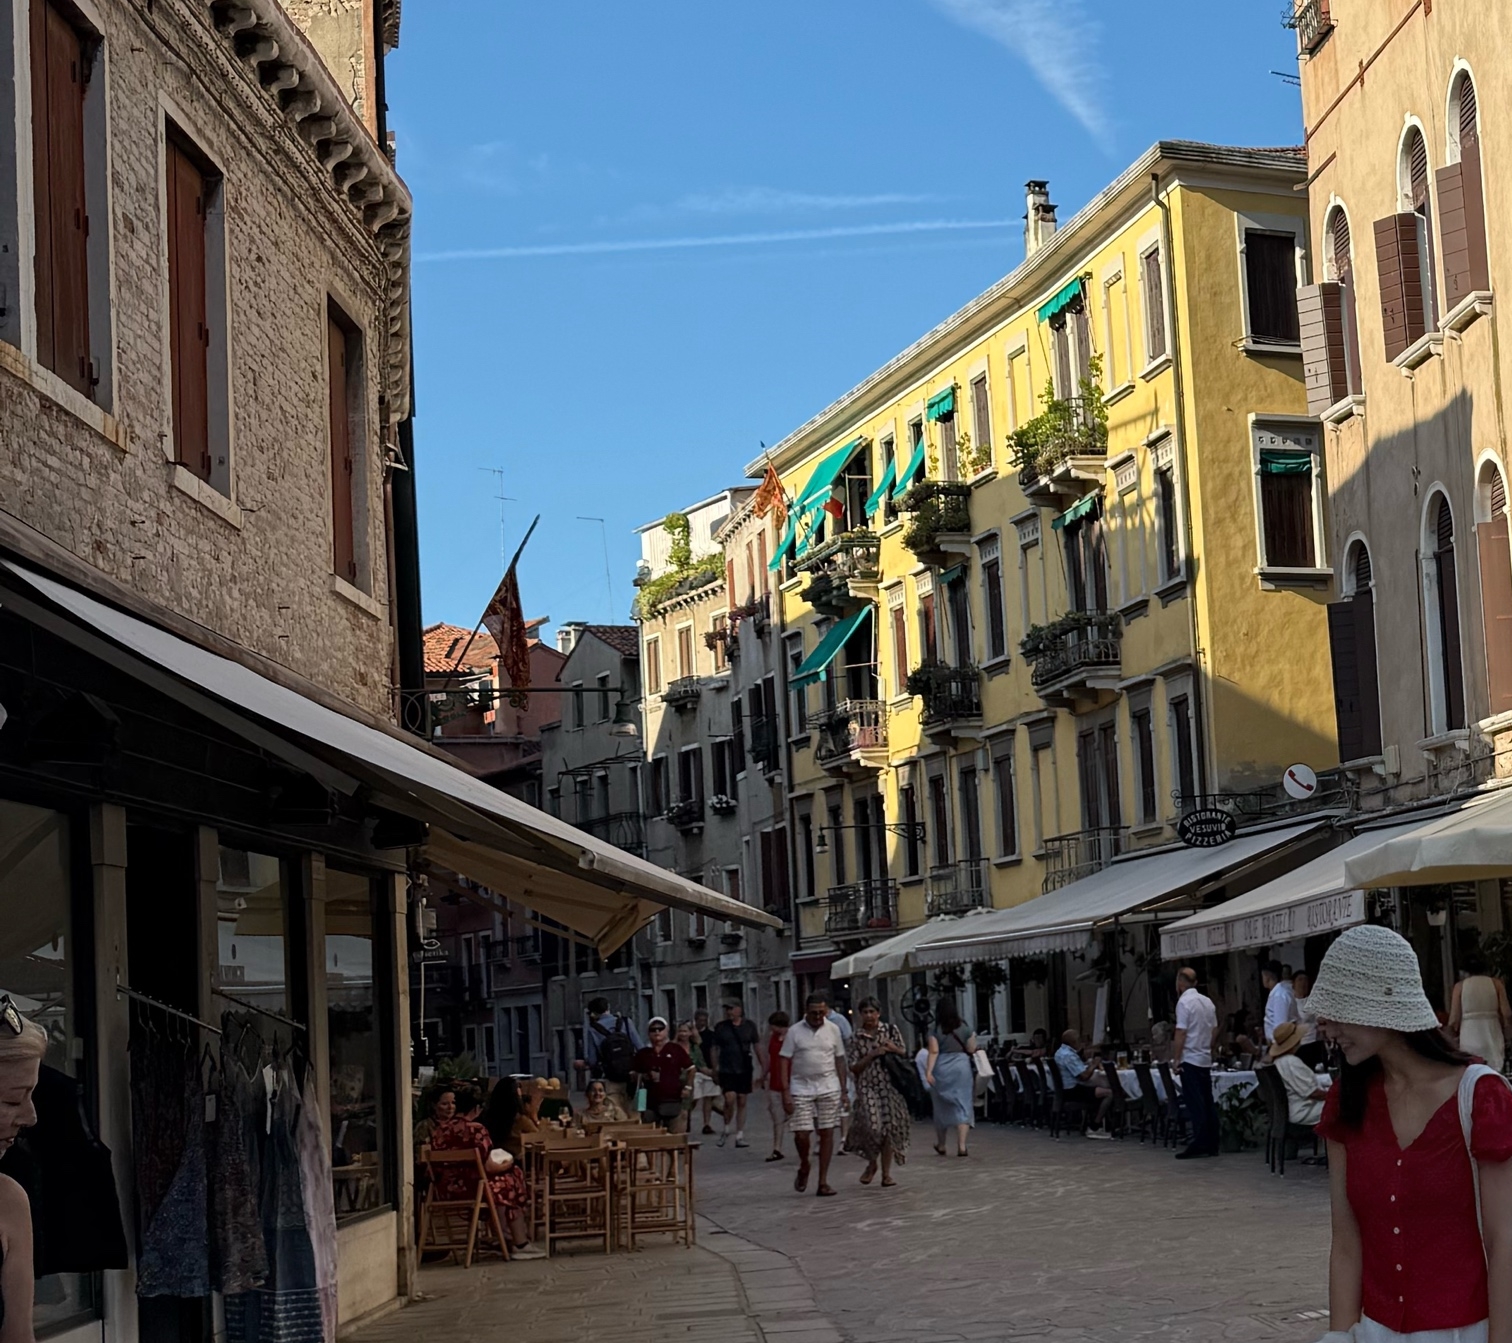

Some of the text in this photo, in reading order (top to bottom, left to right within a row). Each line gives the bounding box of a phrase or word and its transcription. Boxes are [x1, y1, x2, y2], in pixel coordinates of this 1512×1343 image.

[1183, 811, 1231, 827] RISTORANTE
[1190, 822, 1226, 833] VESUVIO
[1185, 830, 1232, 845] PIZZERIA
[1306, 894, 1353, 931] RISTORANTE
